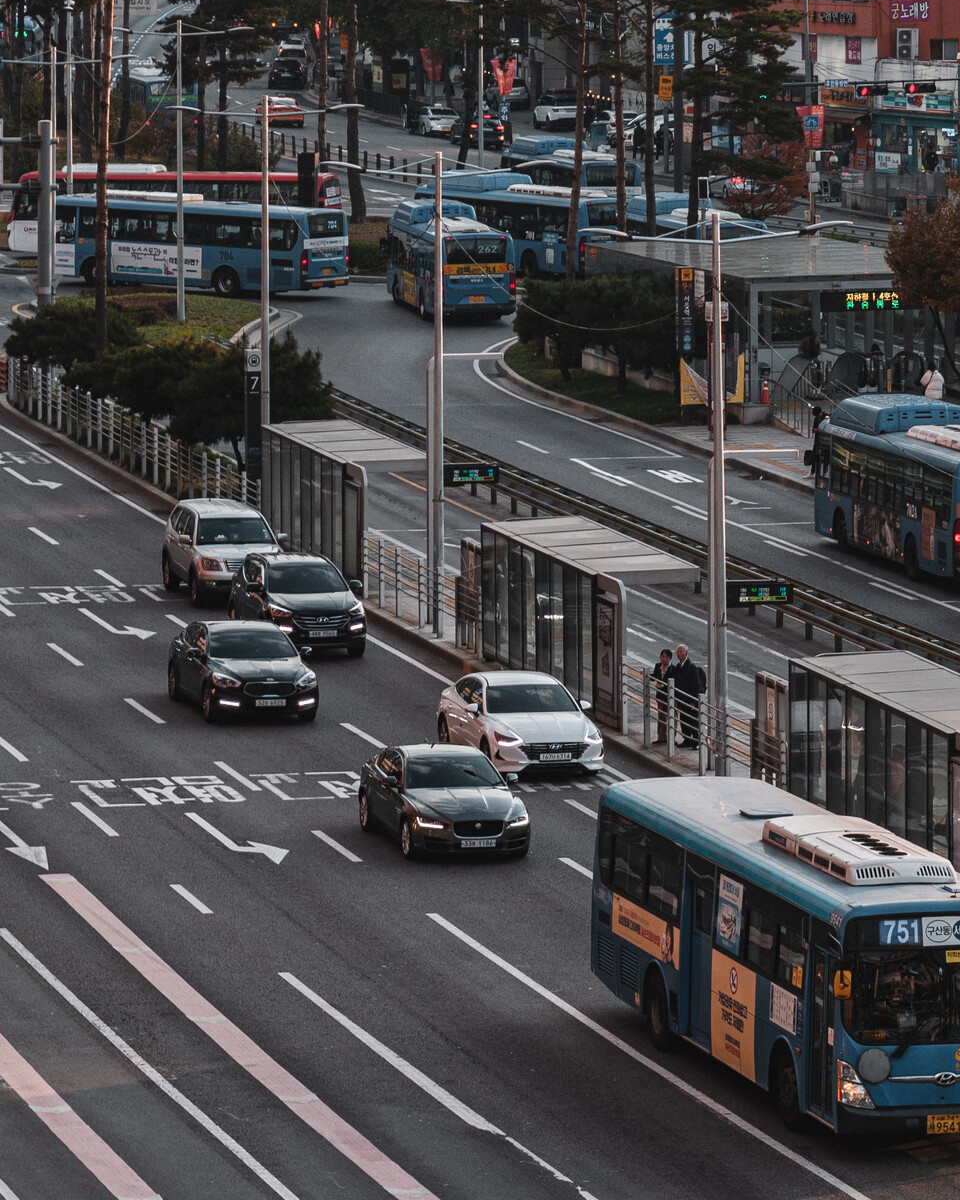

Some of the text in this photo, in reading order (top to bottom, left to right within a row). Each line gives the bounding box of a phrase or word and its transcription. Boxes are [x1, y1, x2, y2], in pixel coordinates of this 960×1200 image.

[891, 1, 929, 20] 궁노래방
[219, 251, 234, 260] 704
[478, 245, 498, 254] 262
[884, 919, 919, 944] 751
[927, 925, 951, 937] 구산동
